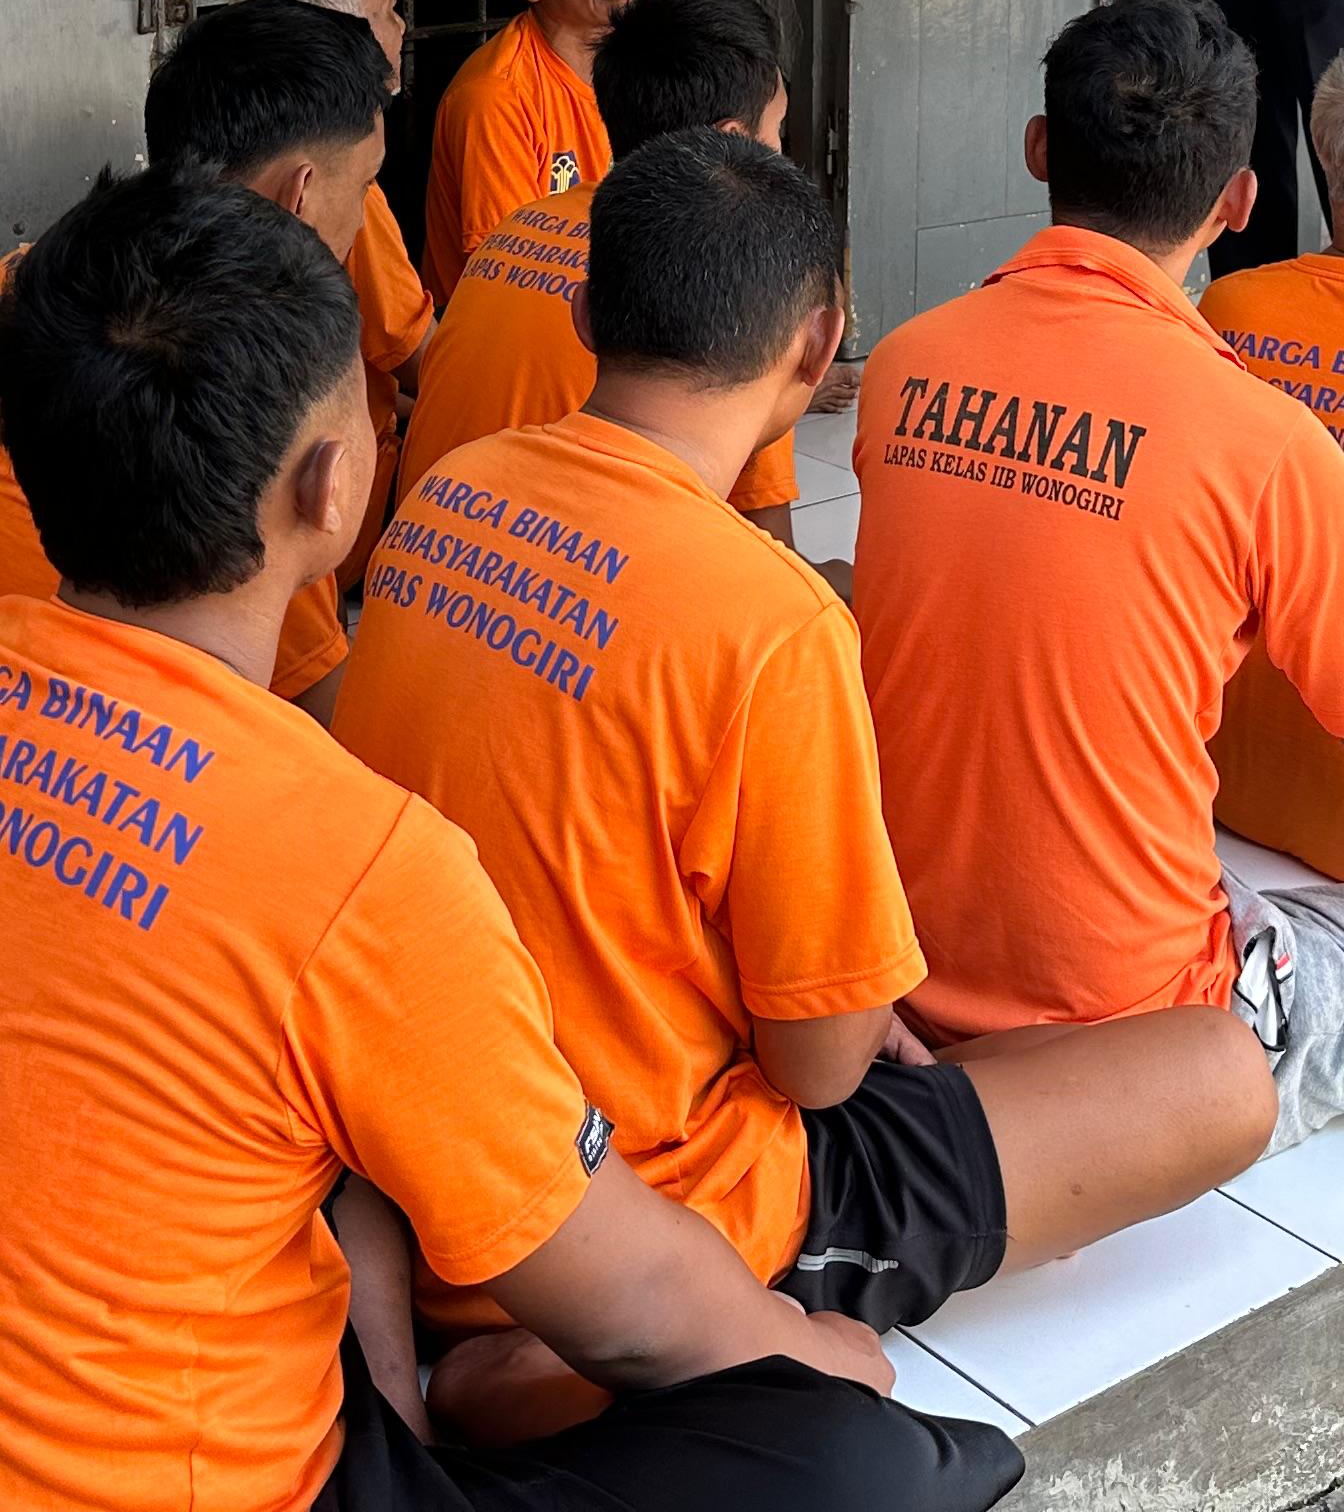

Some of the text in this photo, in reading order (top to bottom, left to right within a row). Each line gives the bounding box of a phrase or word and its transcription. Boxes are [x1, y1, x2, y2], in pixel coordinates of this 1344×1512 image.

[481, 233, 590, 269] PEMASYARAK
[884, 444, 1125, 521] LAPAS KELAS IIB WONOGIRI
[894, 376, 1147, 489] TAHANAN
[418, 475, 629, 584] WARGA BINAAN
[367, 564, 595, 702] APAS WONOGIRI
[382, 520, 619, 650] PEMASYARAKATAN
[41, 679, 215, 784] BINAAN
